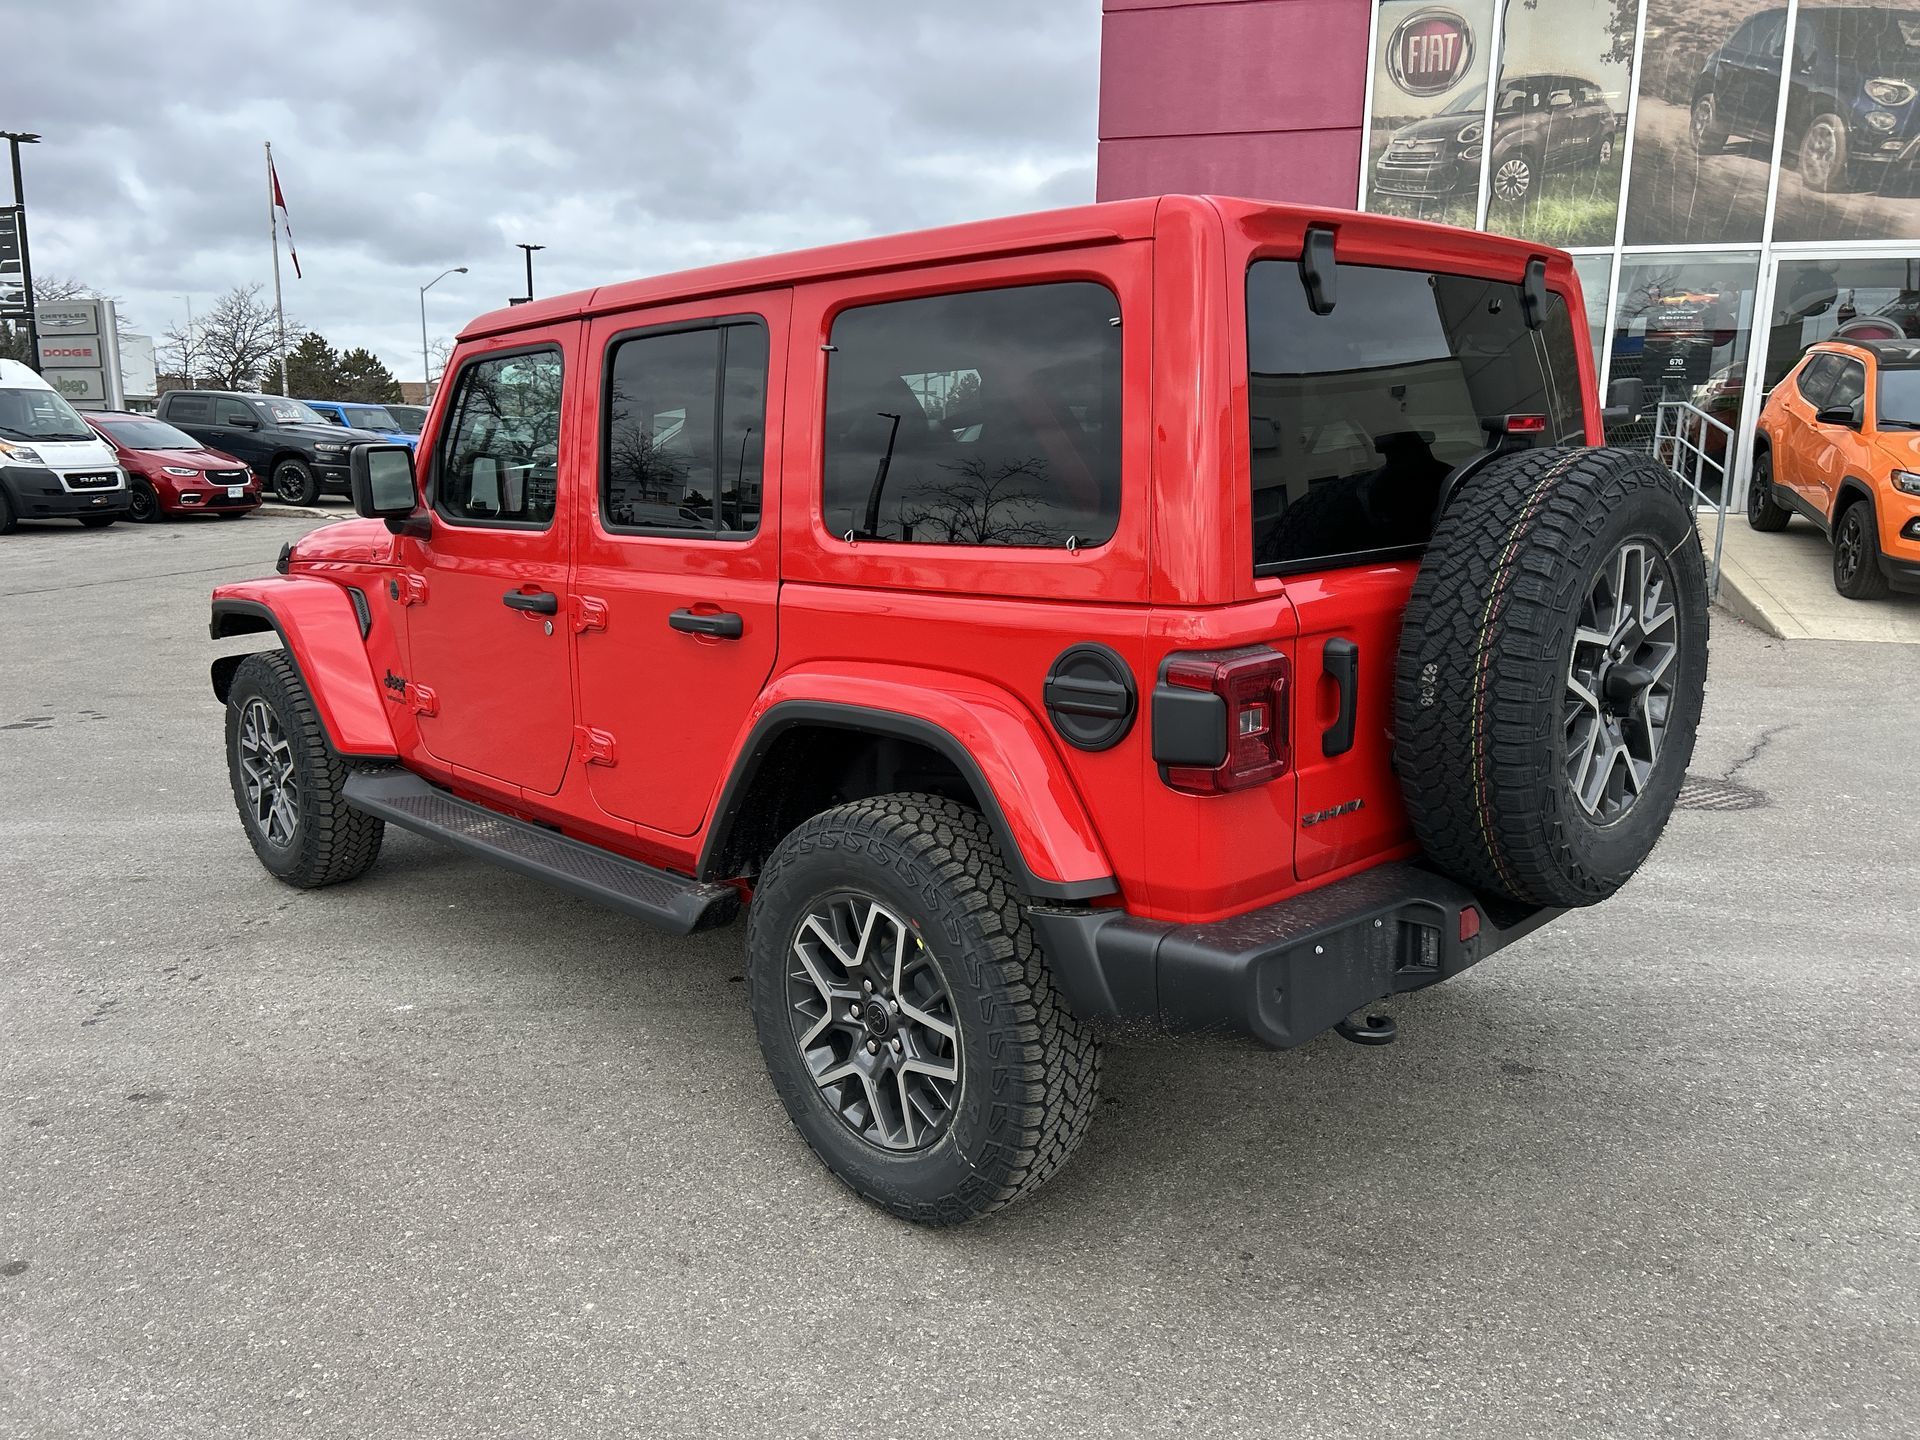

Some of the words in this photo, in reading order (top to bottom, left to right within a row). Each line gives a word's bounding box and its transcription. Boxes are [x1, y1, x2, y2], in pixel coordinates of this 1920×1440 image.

[1407, 33, 1458, 74] FIAT
[40, 312, 87, 320] CHRYSLER
[43, 348, 92, 358] DODGE
[1669, 358, 1684, 366] 670
[54, 376, 88, 395] Jeep
[275, 409, 300, 418] Sold
[384, 669, 406, 697] Jeep
[1302, 799, 1365, 828] SAHARA
